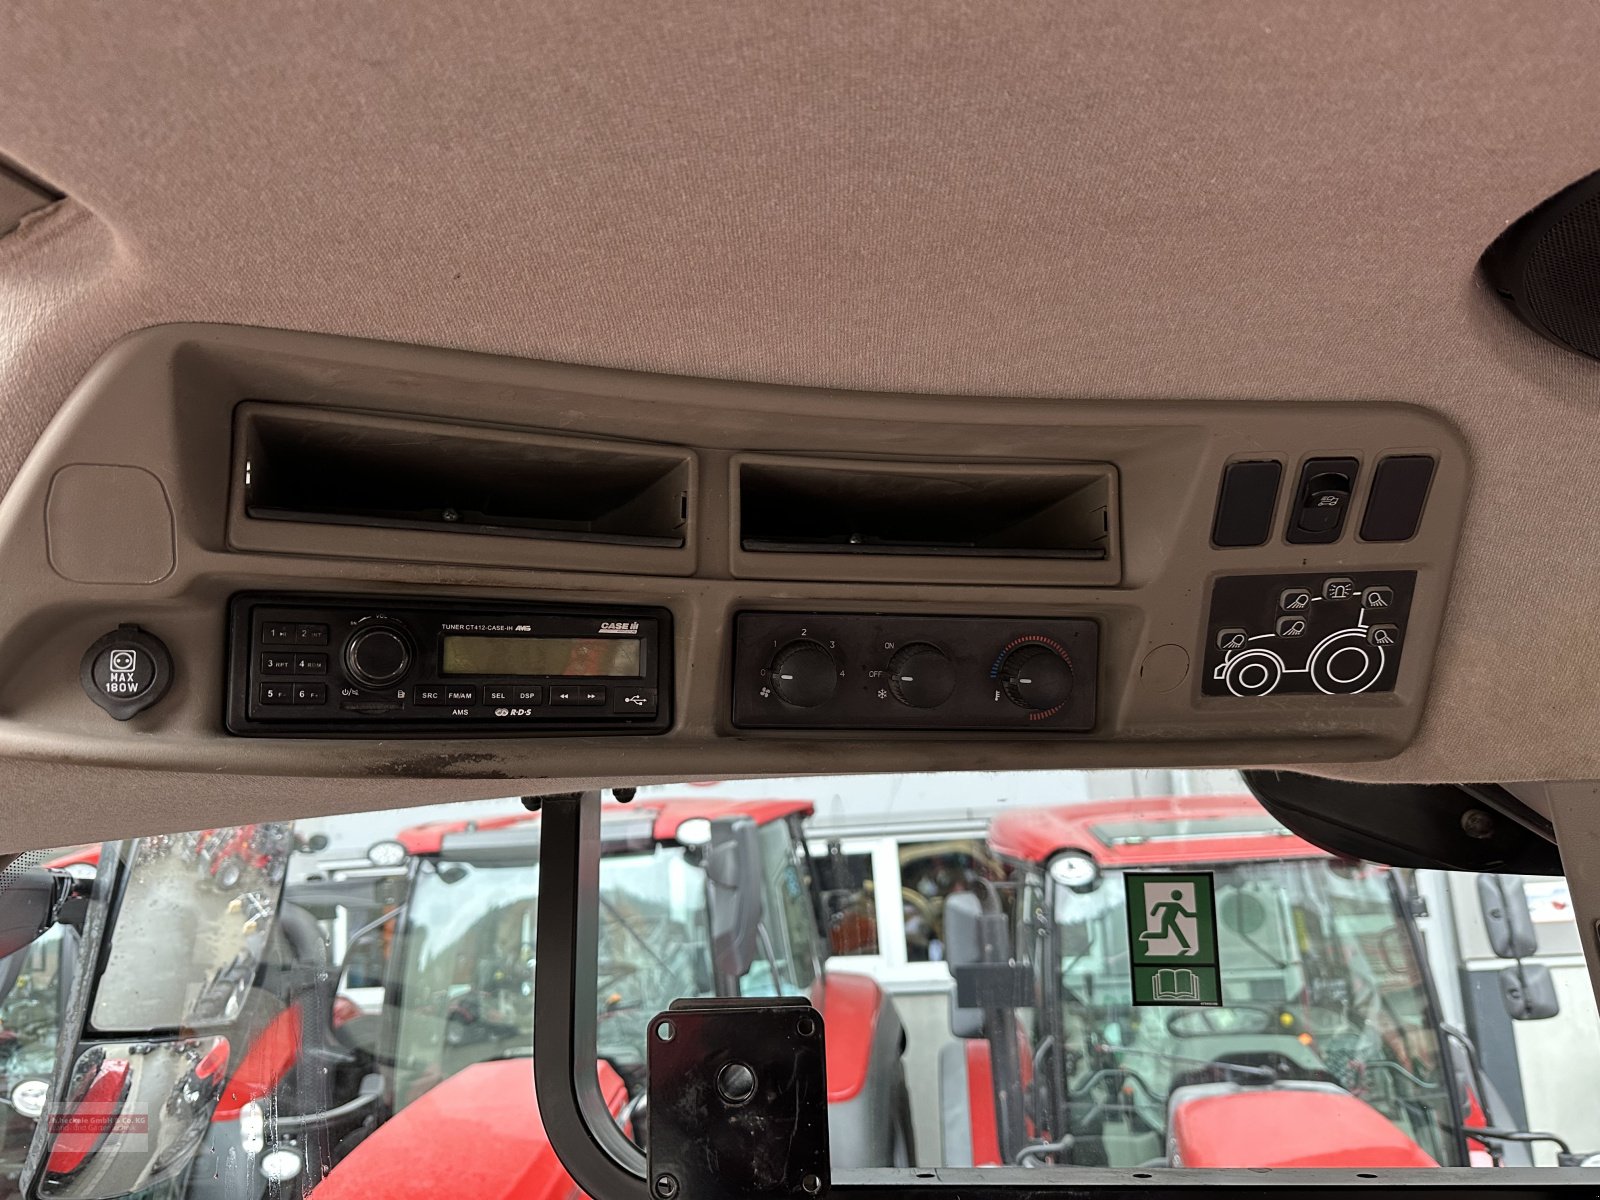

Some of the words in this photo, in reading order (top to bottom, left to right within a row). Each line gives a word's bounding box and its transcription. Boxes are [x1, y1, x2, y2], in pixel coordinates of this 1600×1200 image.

[600, 622, 630, 630] CASE
[270, 629, 275, 637] 1
[301, 629, 307, 637] 2
[801, 628, 807, 636] 2
[884, 641, 895, 649] ON
[267, 659, 273, 667] 3
[298, 660, 305, 668] 4
[110, 672, 134, 682] MAX
[868, 670, 883, 678] OFF
[105, 683, 139, 692] 180W
[267, 690, 273, 698] 5
[299, 690, 305, 698] 6
